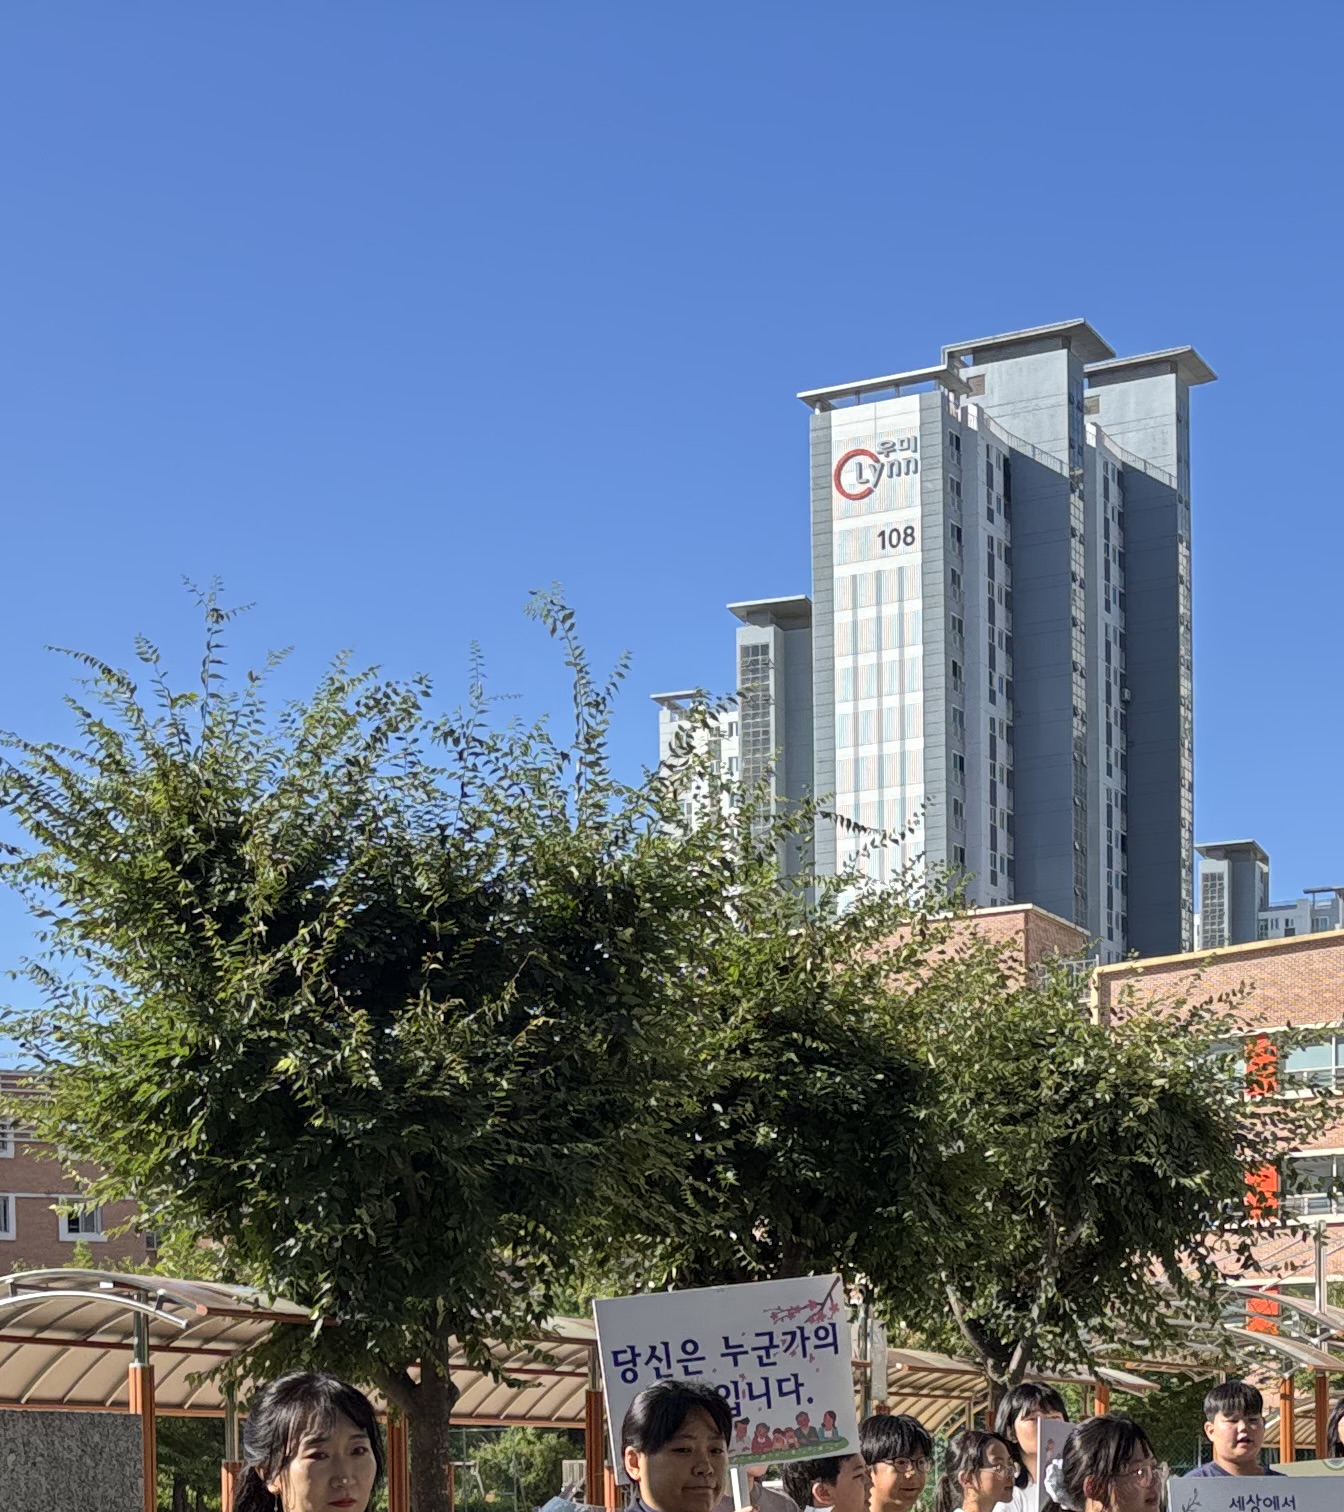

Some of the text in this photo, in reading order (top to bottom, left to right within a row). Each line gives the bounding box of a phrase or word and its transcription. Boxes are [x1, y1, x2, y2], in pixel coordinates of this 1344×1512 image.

[856, 457, 919, 489] Lynn
[877, 525, 915, 550] 108
[611, 1321, 840, 1385] 당신은 누군가의
[720, 1372, 814, 1417] 입니다.
